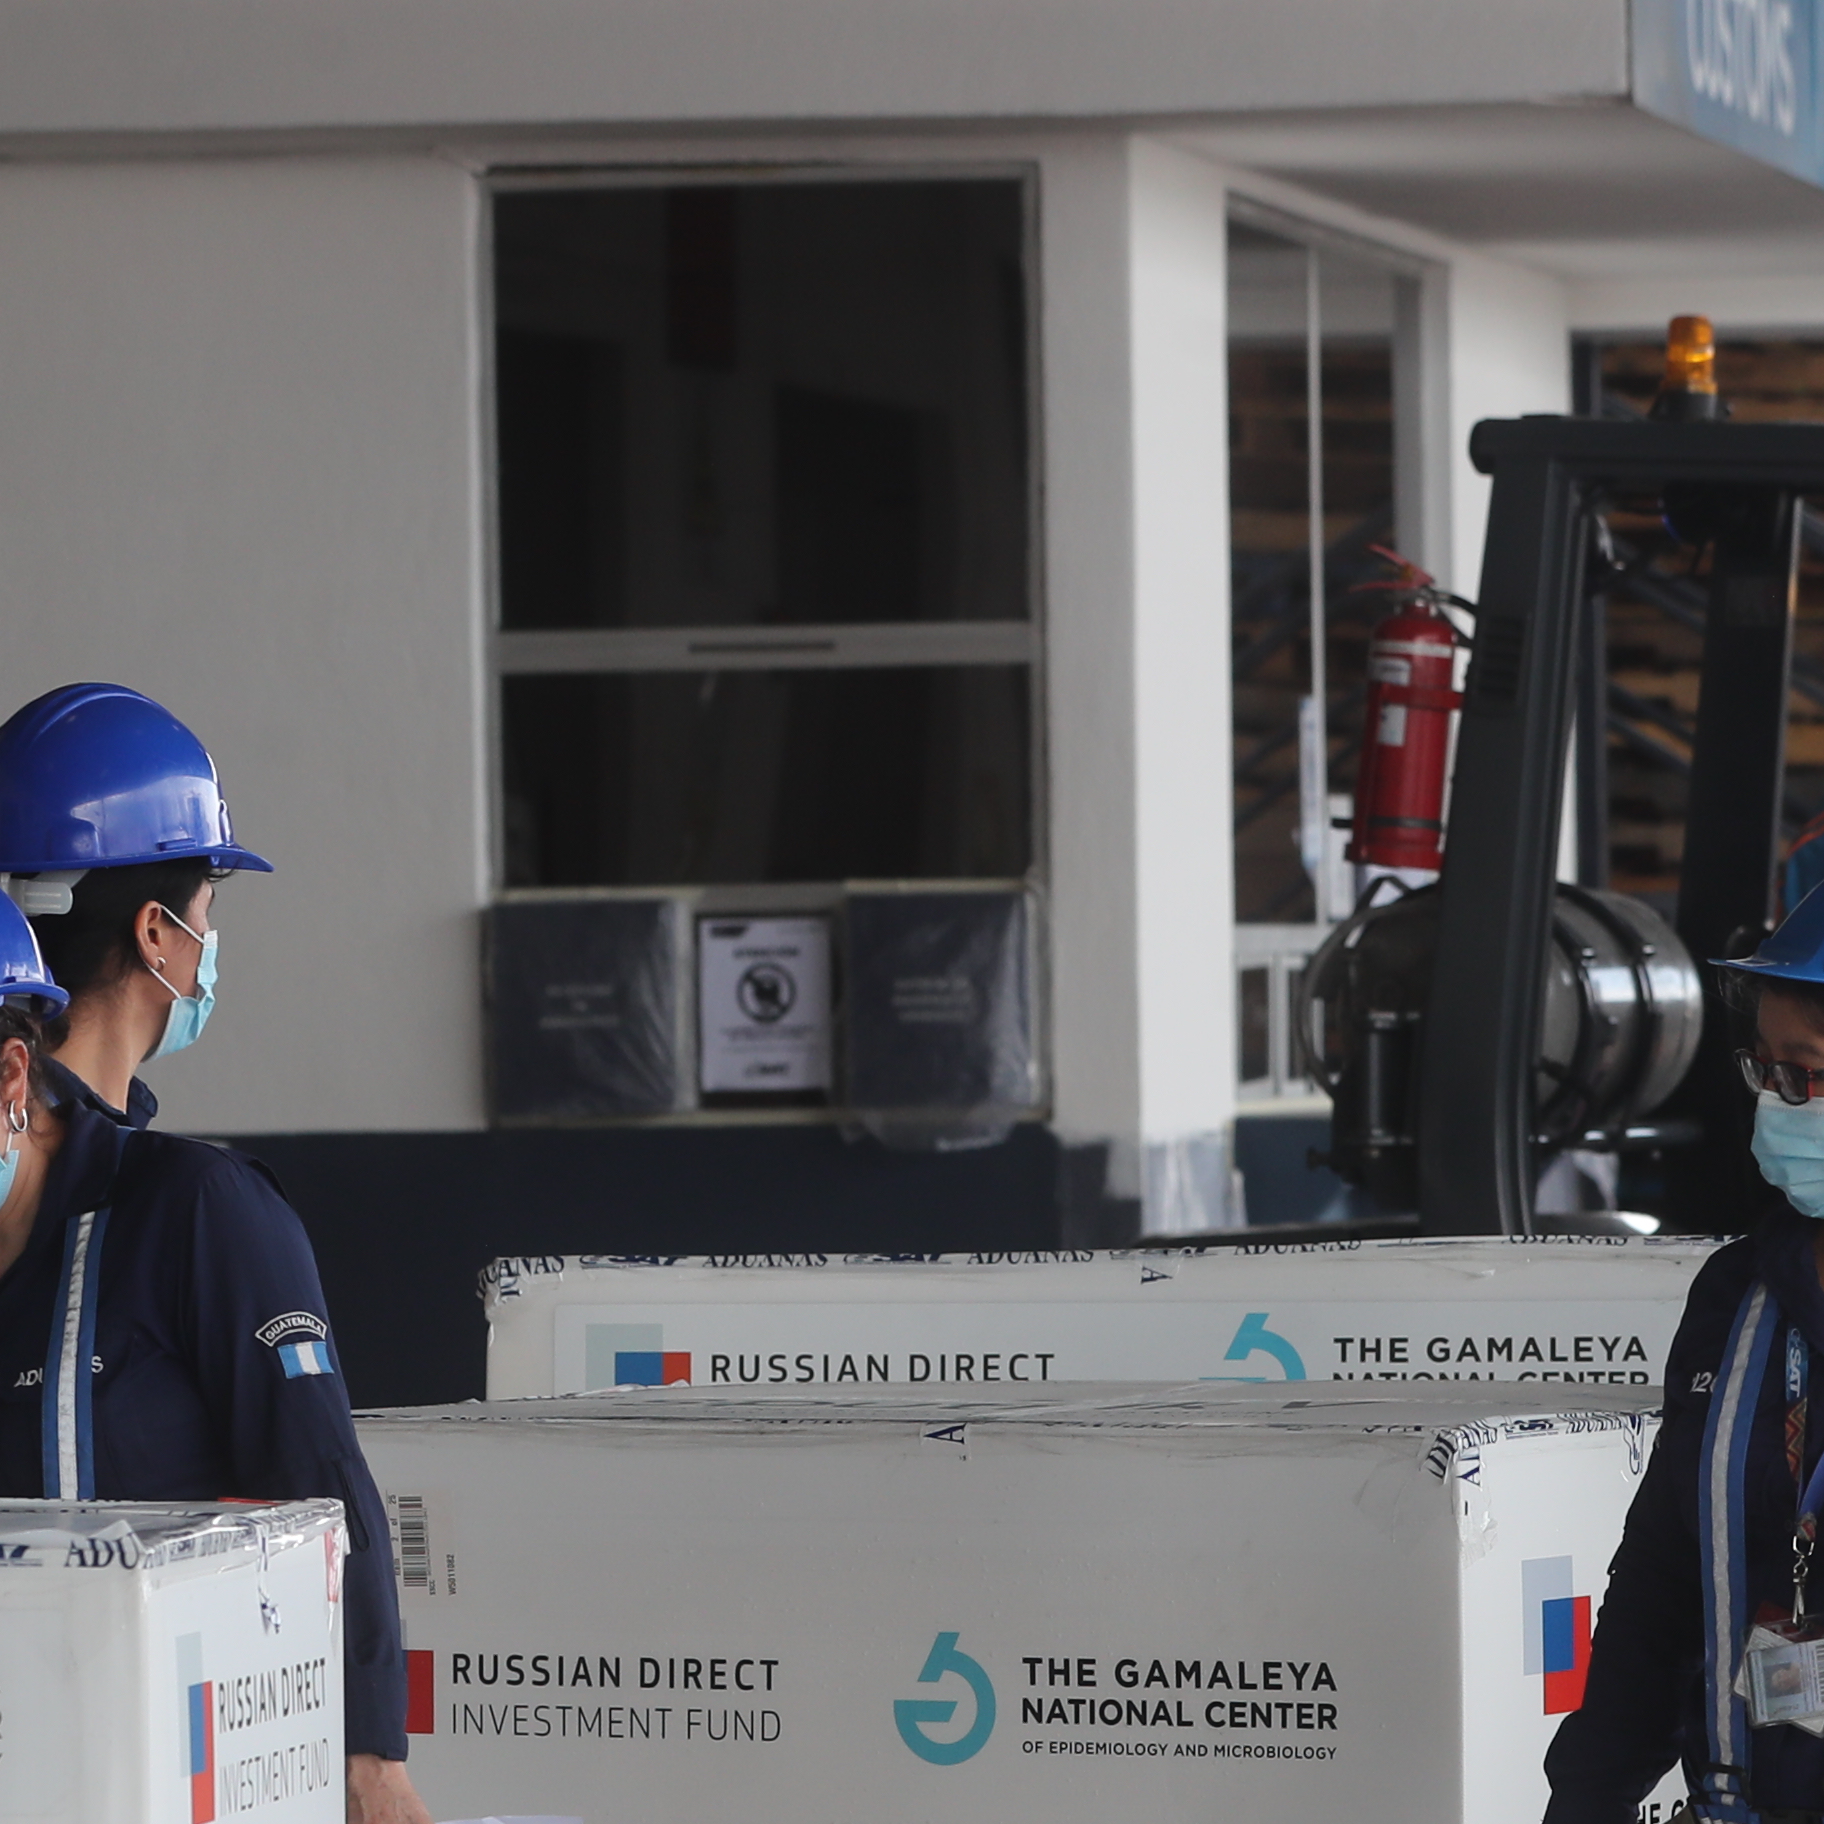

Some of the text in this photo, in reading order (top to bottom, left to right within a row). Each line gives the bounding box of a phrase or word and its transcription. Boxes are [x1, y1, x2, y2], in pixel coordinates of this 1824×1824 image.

[1334, 1336, 1648, 1363] THE GAMALEYA
[712, 1354, 1054, 1383] RUSSIAN DIRECT
[453, 1654, 778, 1690] RUSSIAN DIRECT
[1022, 1658, 1337, 1691] THE GAMALEYA
[219, 1657, 325, 1732] RUSSIAN DIRECT
[453, 1704, 780, 1741] INVESTMENT FUND
[1022, 1698, 1337, 1730] NATIONAL CENTER
[1022, 1741, 1336, 1760] OF EPIDEMIOLOGY AND MICROBIOLOGY
[219, 1738, 329, 1817] INVESTMENT FUND
